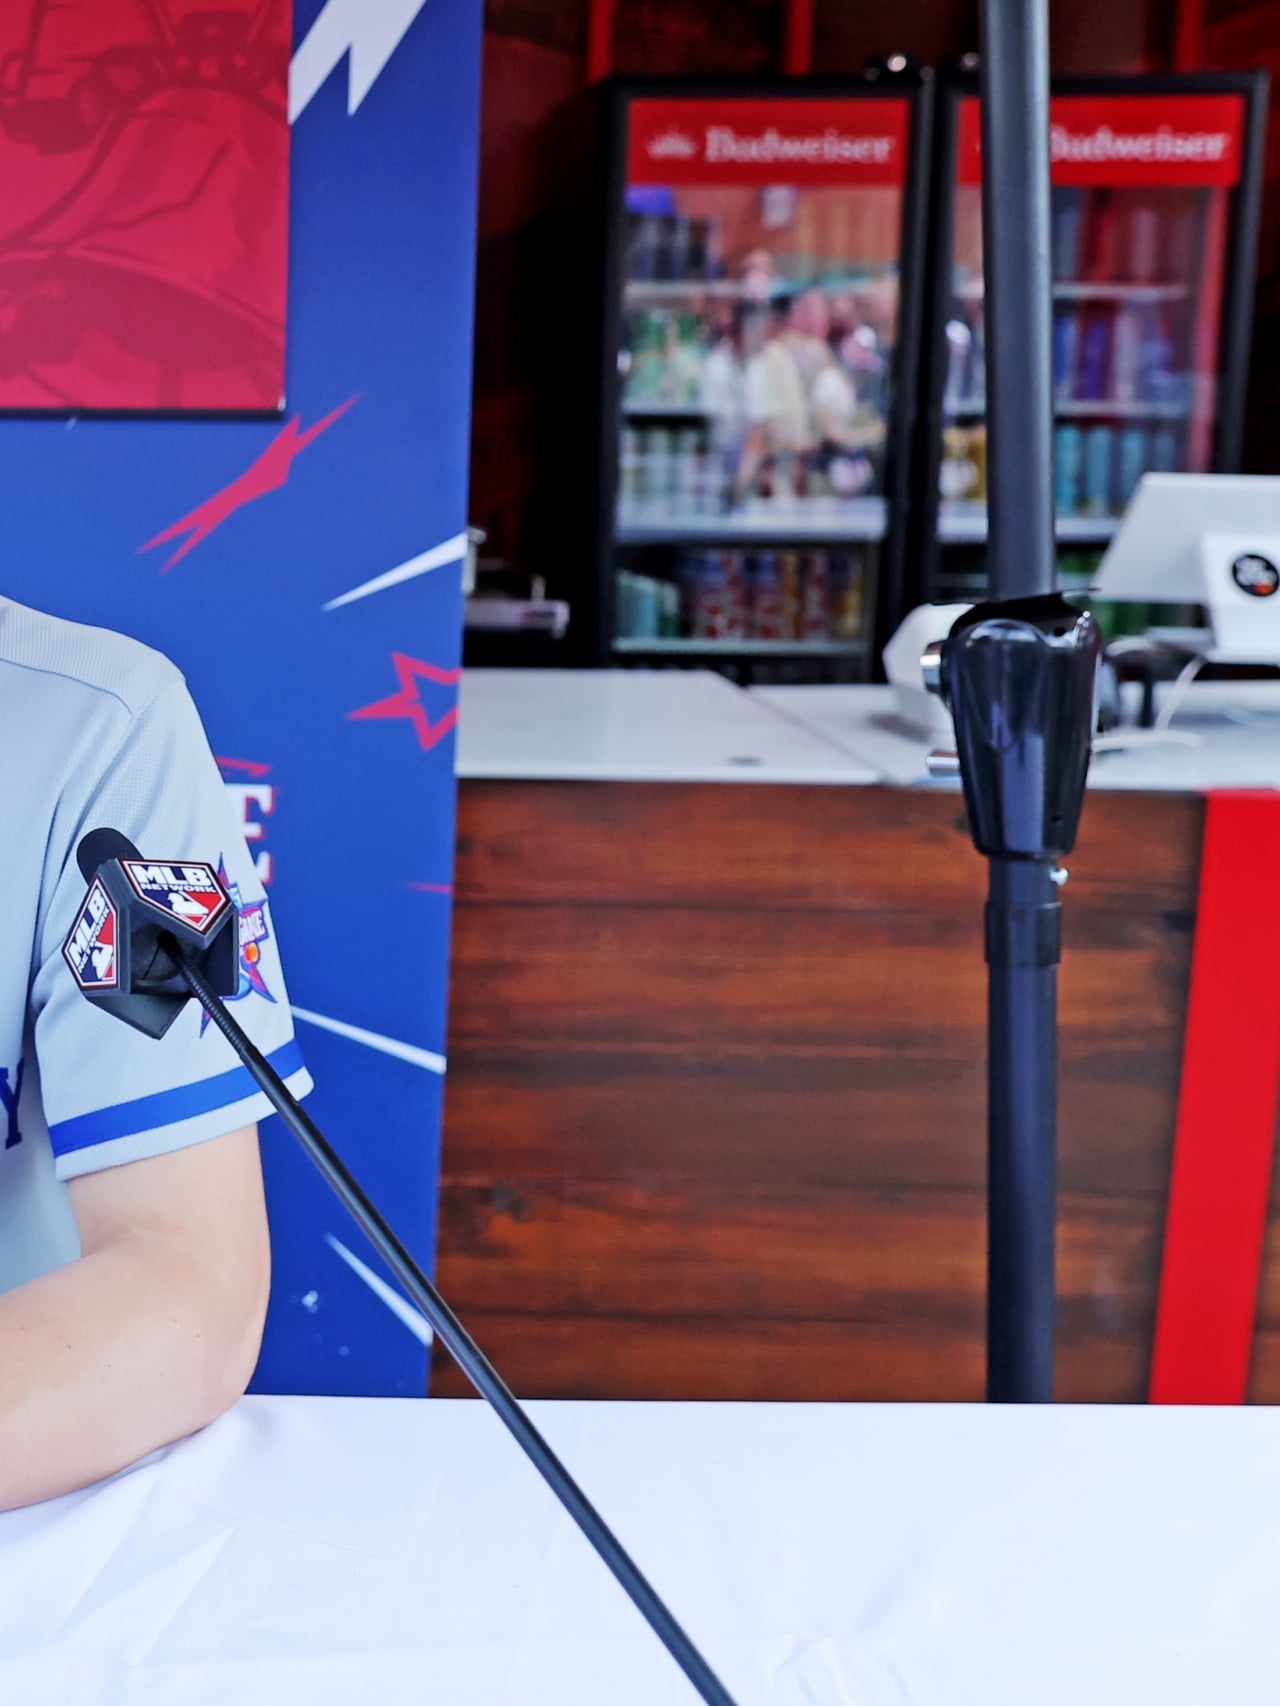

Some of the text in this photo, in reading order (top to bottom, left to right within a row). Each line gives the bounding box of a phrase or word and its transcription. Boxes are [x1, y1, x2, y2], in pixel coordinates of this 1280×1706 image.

[705, 125, 896, 164] Budweiser
[130, 864, 211, 887] MLB
[140, 882, 217, 894] NETWORK
[68, 888, 106, 969] MLB
